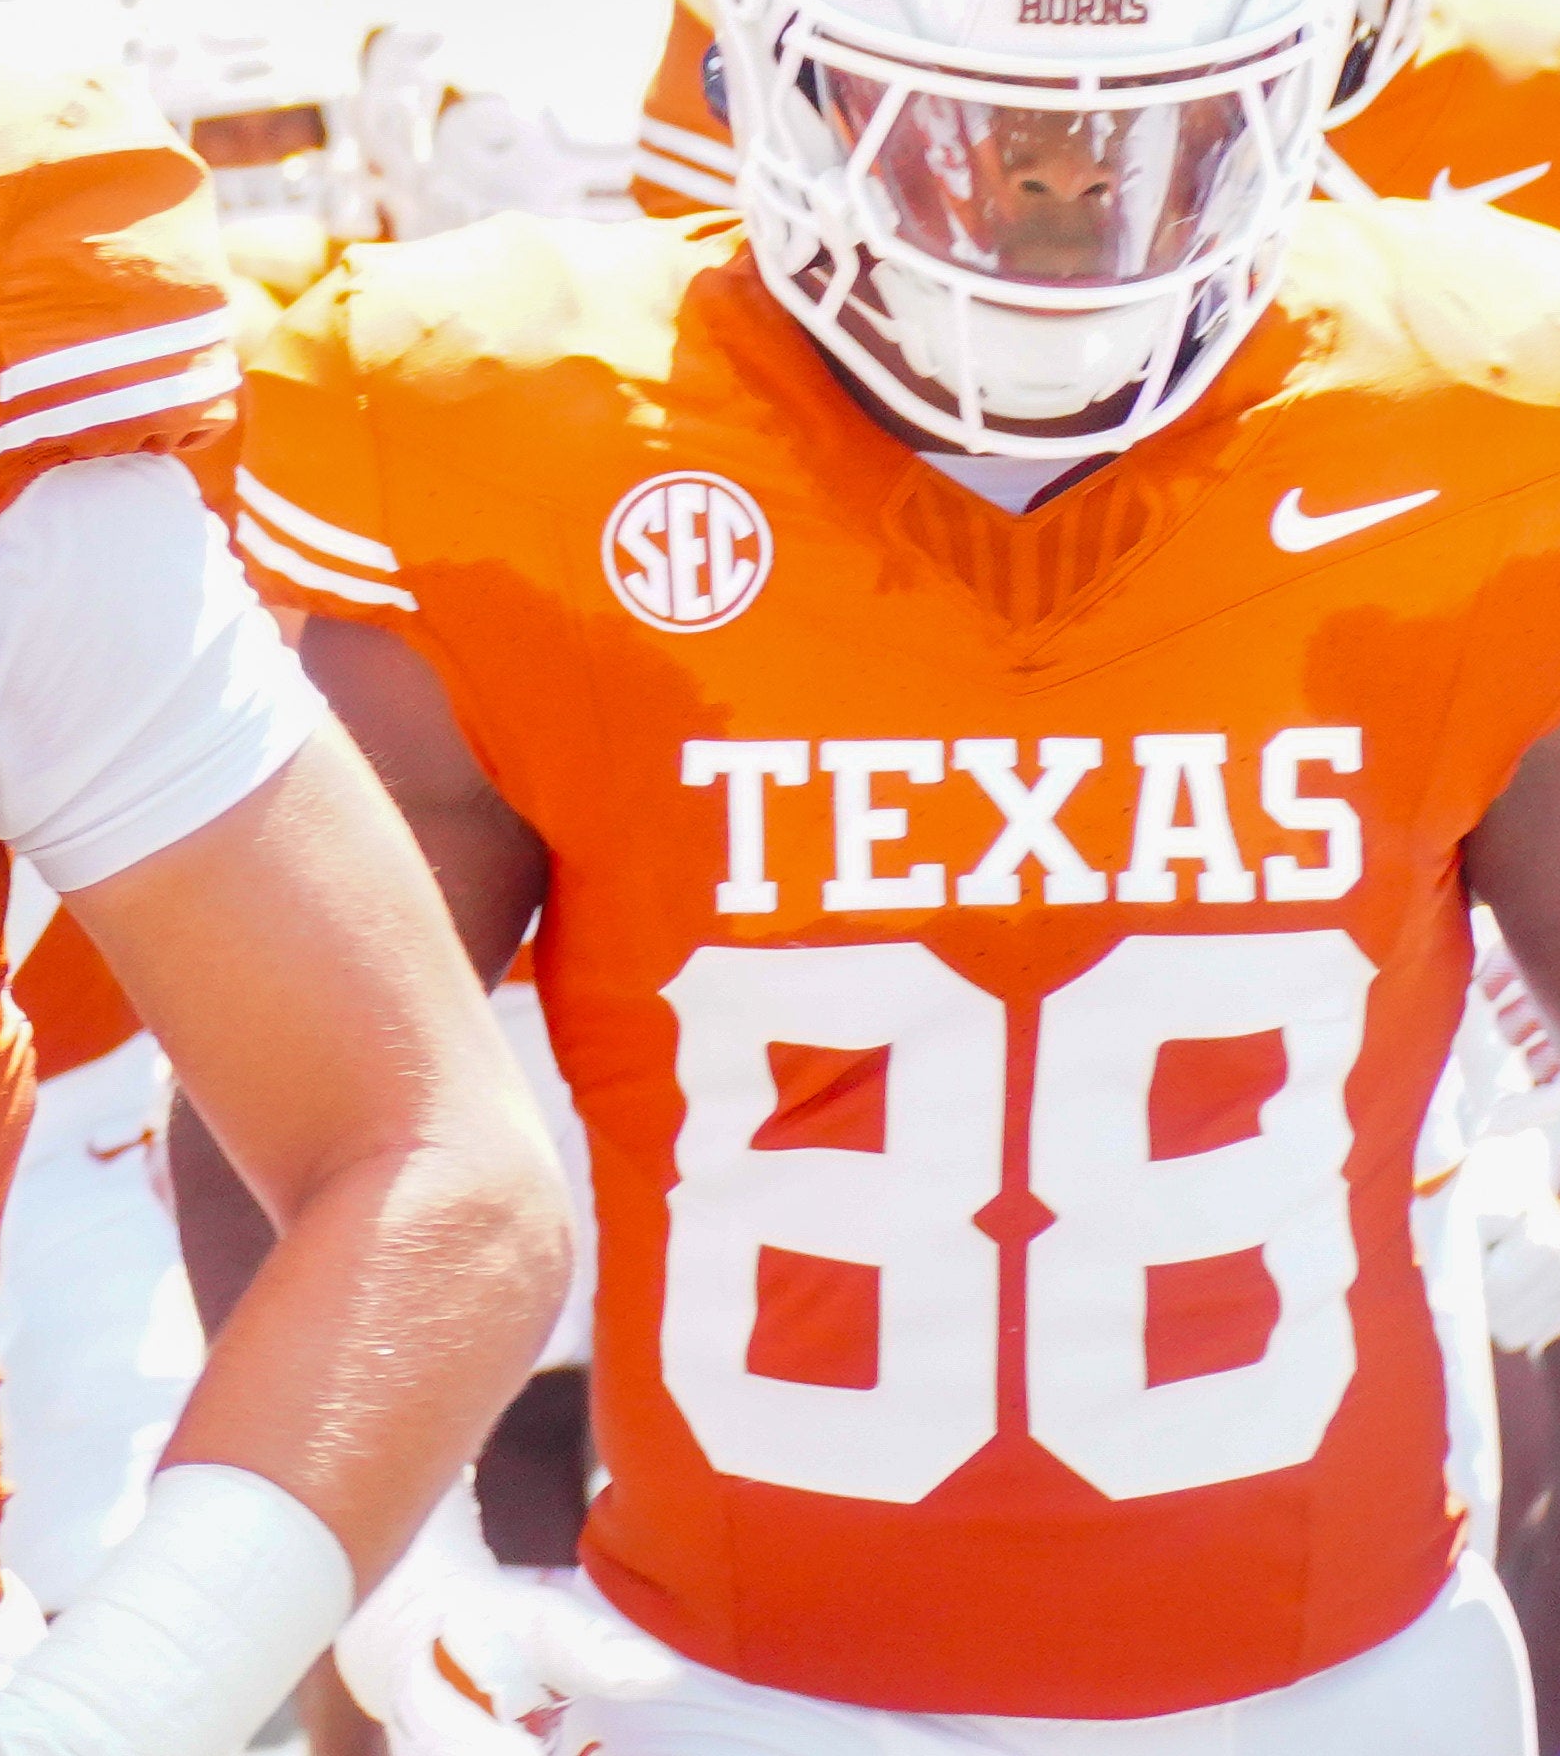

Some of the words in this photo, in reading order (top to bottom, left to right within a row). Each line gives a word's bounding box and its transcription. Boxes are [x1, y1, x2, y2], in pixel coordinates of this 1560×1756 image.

[616, 481, 757, 621] SEC
[680, 726, 1364, 915] TEXAS
[658, 929, 1381, 1505] 88
